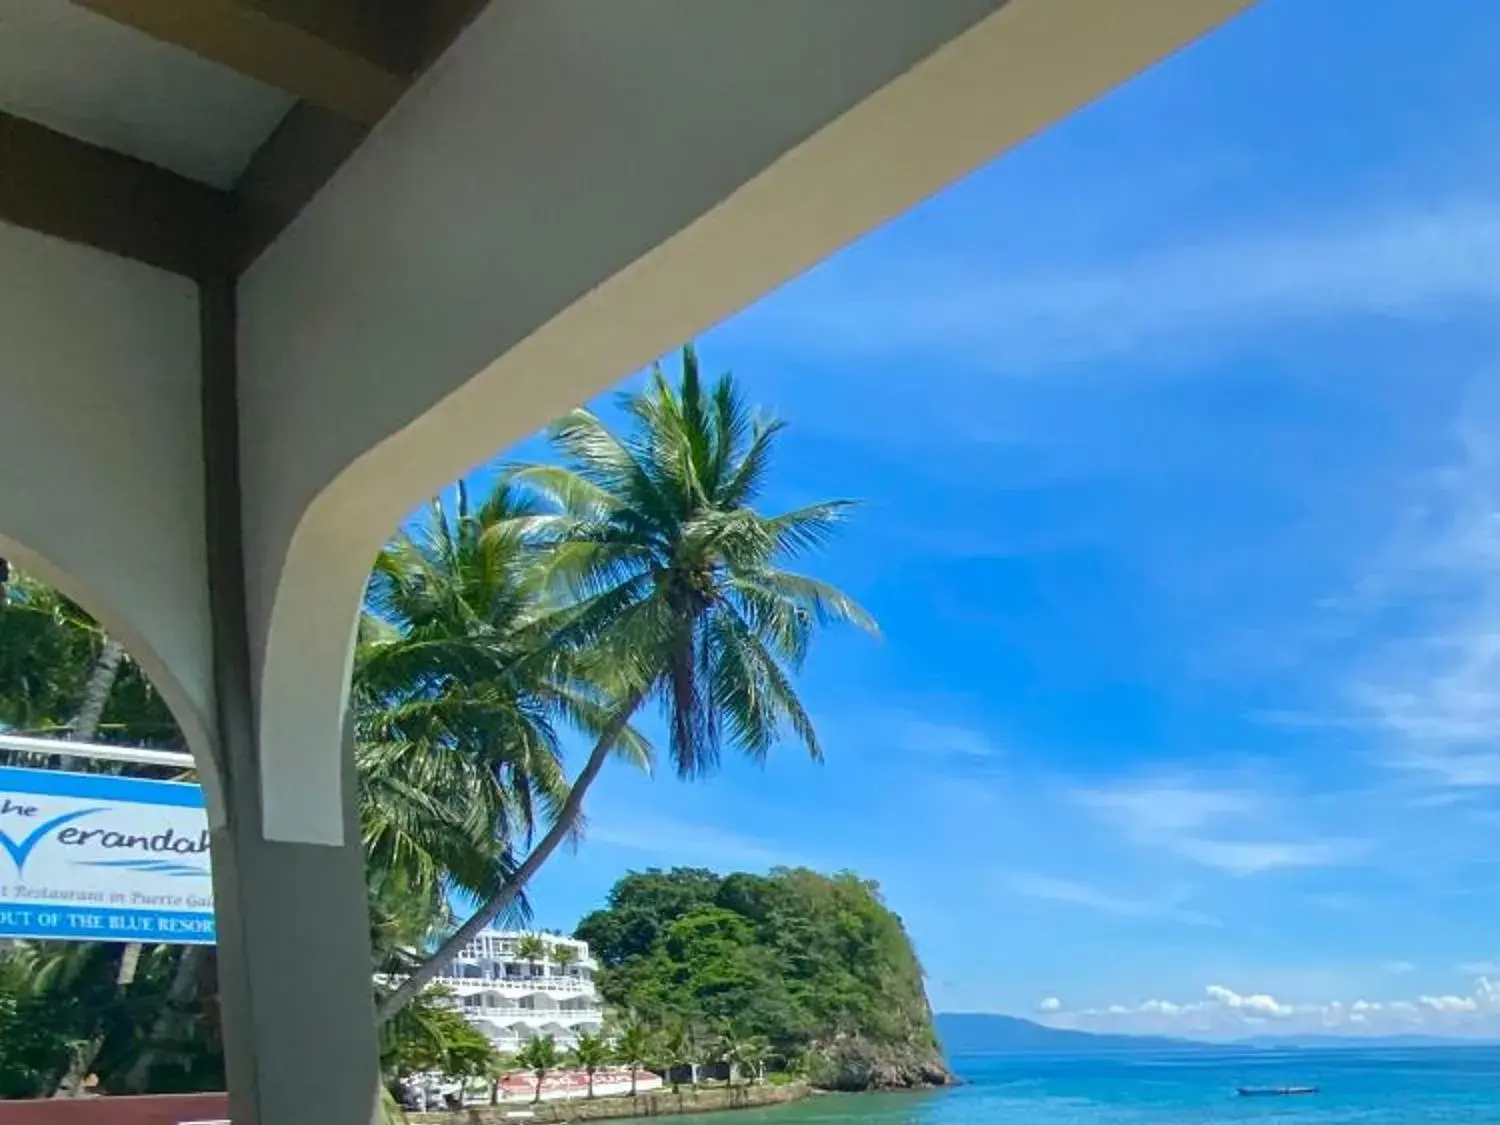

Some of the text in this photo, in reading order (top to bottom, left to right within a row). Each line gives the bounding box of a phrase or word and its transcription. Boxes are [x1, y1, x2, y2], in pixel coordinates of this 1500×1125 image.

[1, 799, 38, 817] he
[37, 911, 61, 927] OF
[66, 913, 105, 929] THE
[108, 915, 154, 931] BLUE
[158, 917, 214, 933] RESOR
